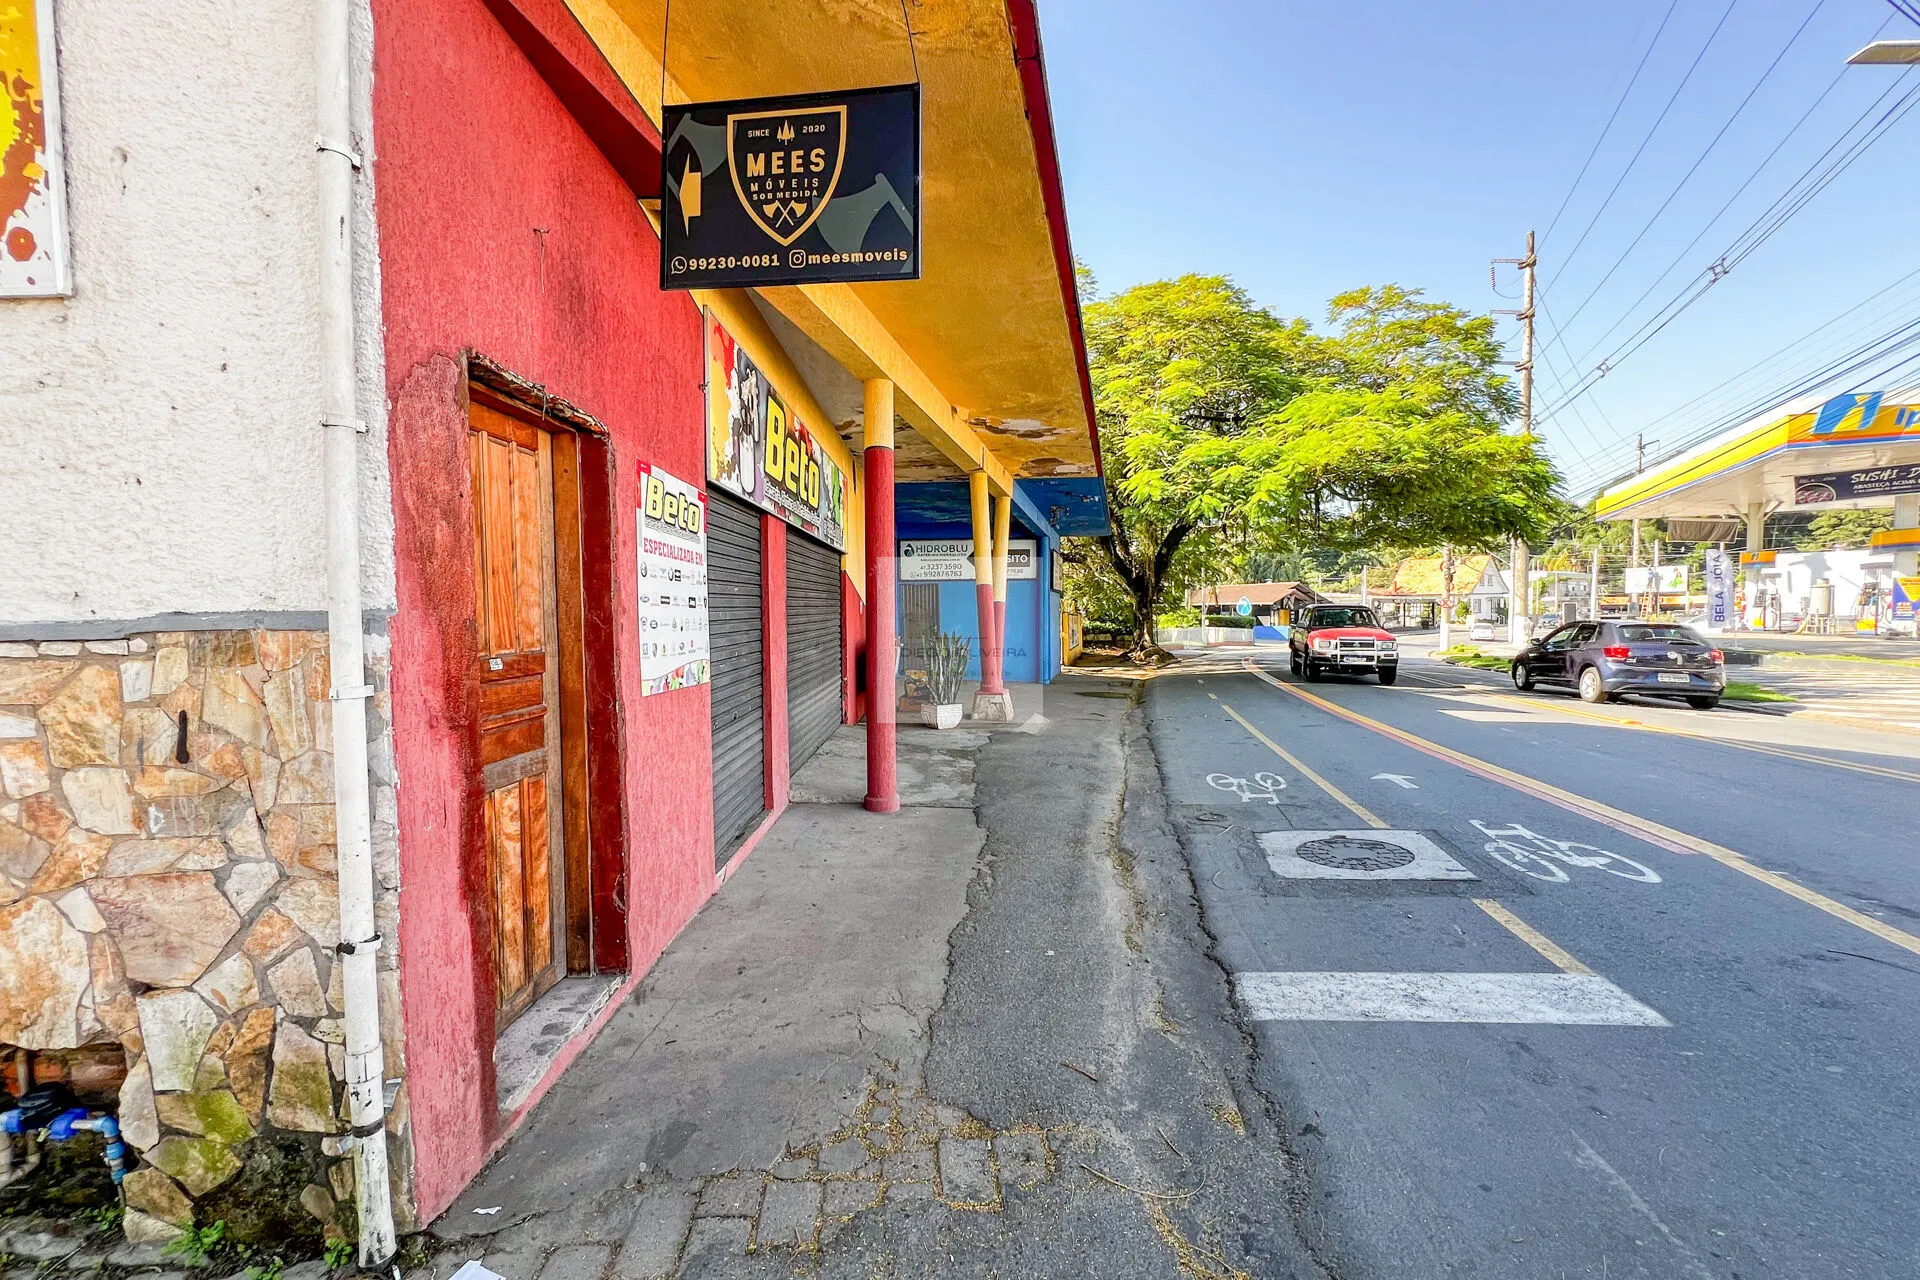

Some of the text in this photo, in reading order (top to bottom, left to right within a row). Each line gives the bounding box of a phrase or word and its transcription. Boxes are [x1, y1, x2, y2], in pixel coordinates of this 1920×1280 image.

[747, 124, 826, 138] SINCE 2020
[746, 147, 826, 178] MEES
[750, 177, 819, 192] MÓVEIS
[752, 189, 818, 201] SOB MEDIDA
[688, 253, 781, 271] 99230-0081
[808, 248, 908, 265] meesmoveis
[764, 394, 820, 510] Beto
[1851, 468, 1899, 484] SUSHI
[644, 474, 701, 535] Beto
[643, 537, 695, 564] ESPECIALIZADA
[915, 544, 968, 553] HIDROBLU
[1710, 554, 1723, 581] JÓIA
[1714, 591, 1725, 622] BELA
